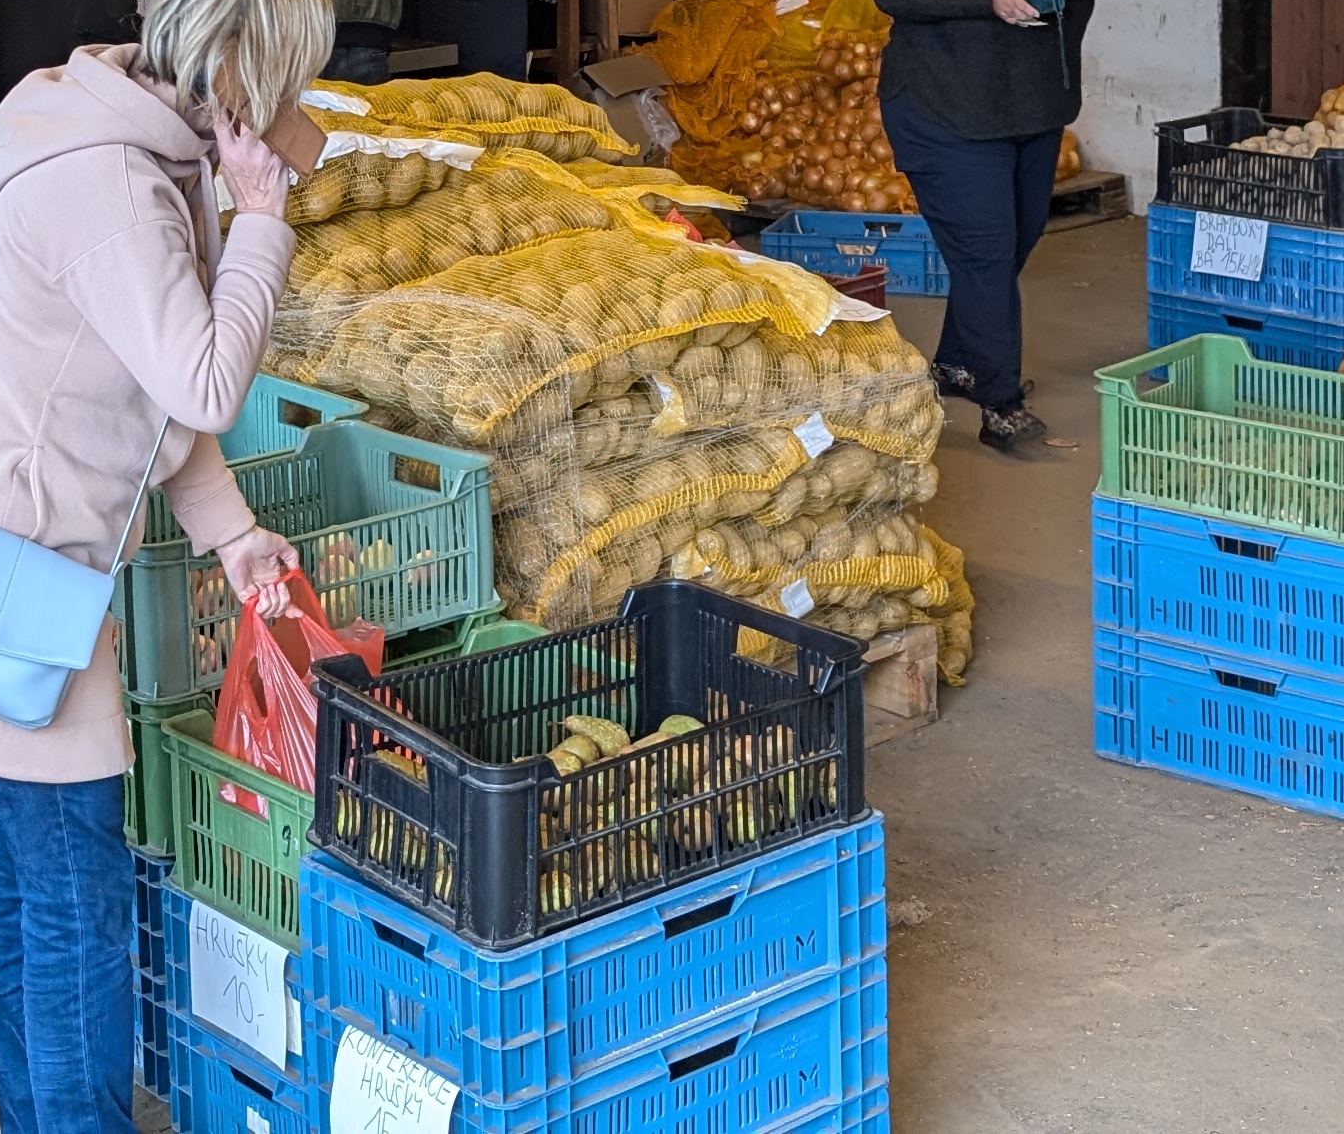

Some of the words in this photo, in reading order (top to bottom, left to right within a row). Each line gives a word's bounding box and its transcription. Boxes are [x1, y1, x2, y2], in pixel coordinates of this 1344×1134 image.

[1198, 213, 1263, 244] BRAMBORY
[1207, 232, 1237, 252] DALI
[196, 907, 269, 992] HRUŠKY
[360, 1062, 422, 1123] HRUŠKY
